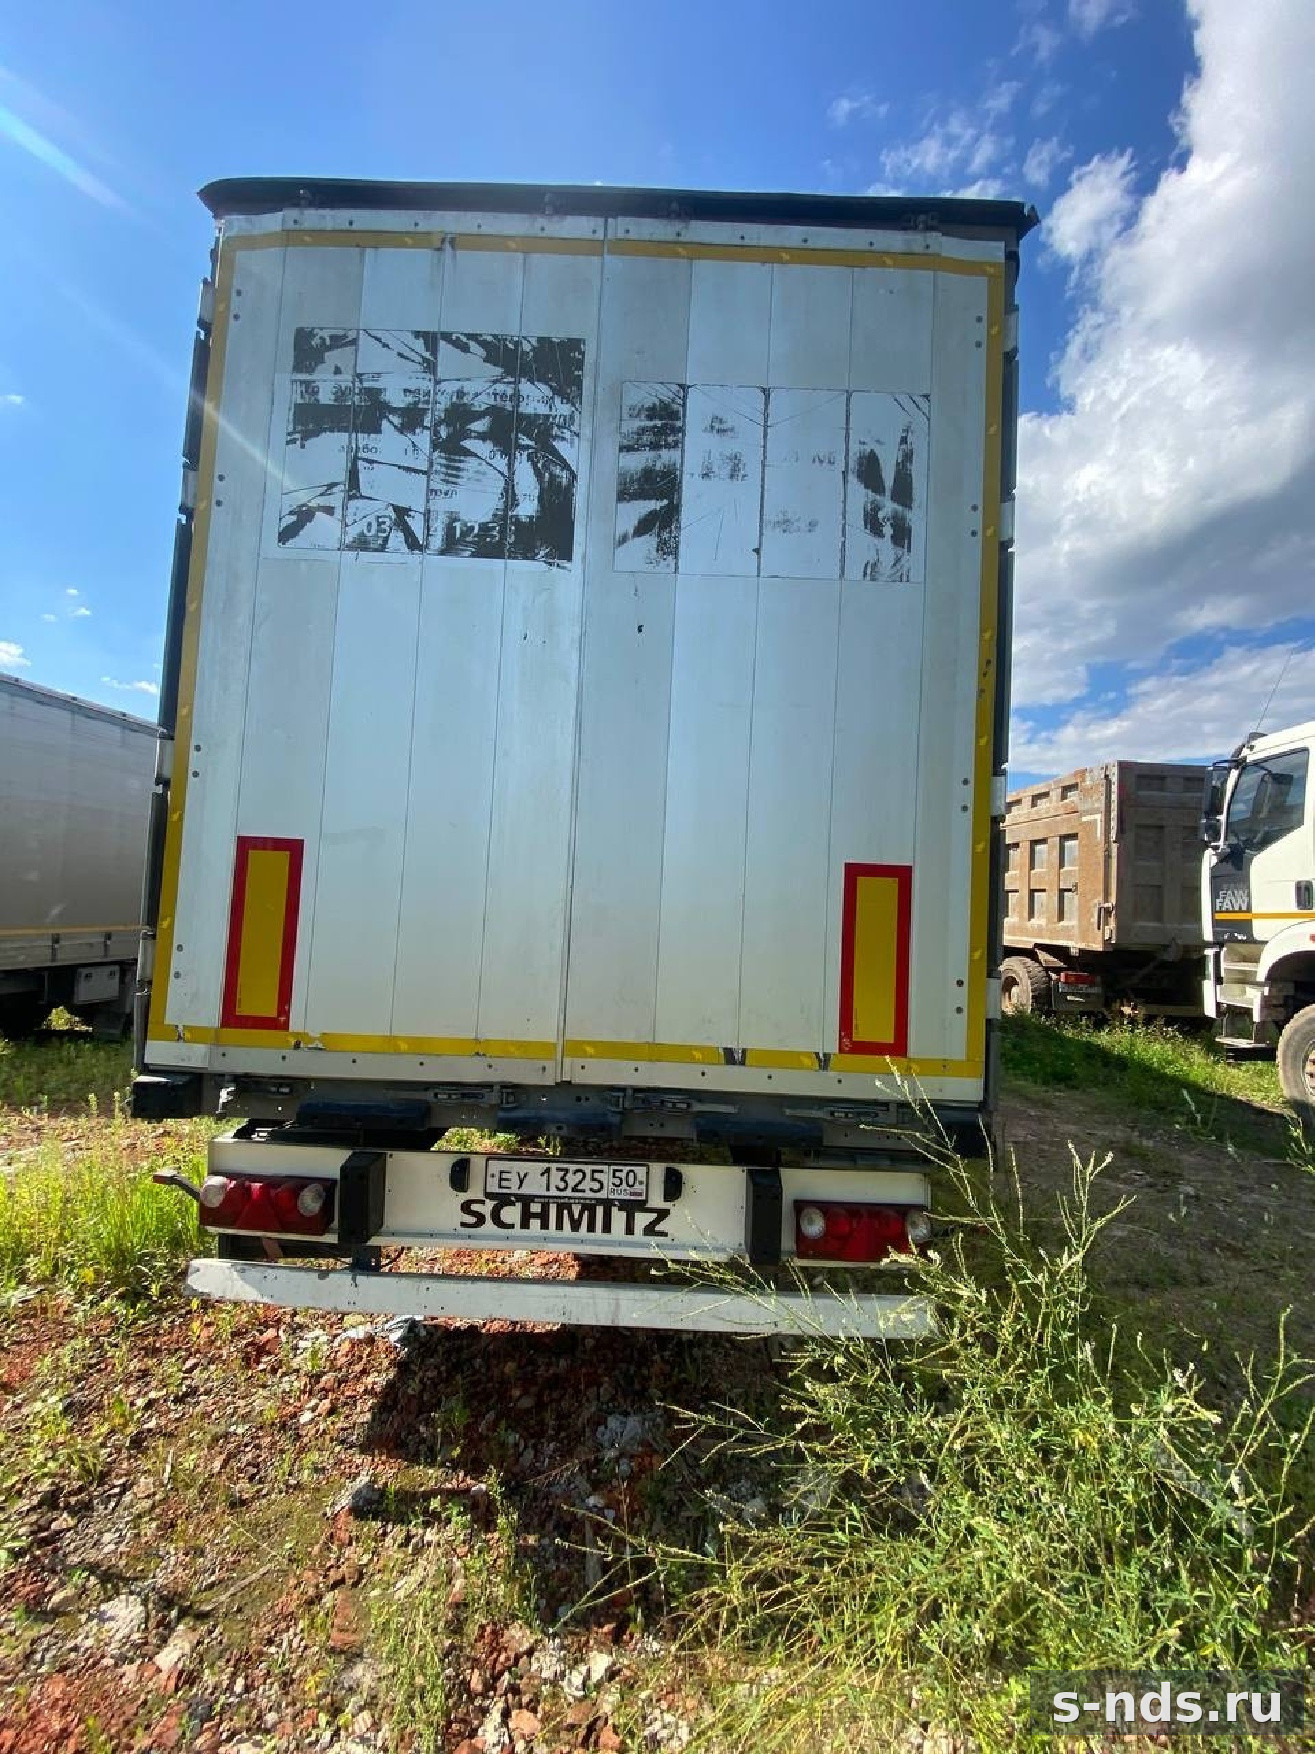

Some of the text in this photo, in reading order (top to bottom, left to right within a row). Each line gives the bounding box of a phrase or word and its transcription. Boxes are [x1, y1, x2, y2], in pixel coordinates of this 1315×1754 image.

[1215, 897, 1249, 911] FAW
[539, 1166, 605, 1194] 1325
[611, 1168, 637, 1188] 50
[610, 1187, 630, 1197] RUS
[459, 1198, 671, 1238] SCHMITZ
